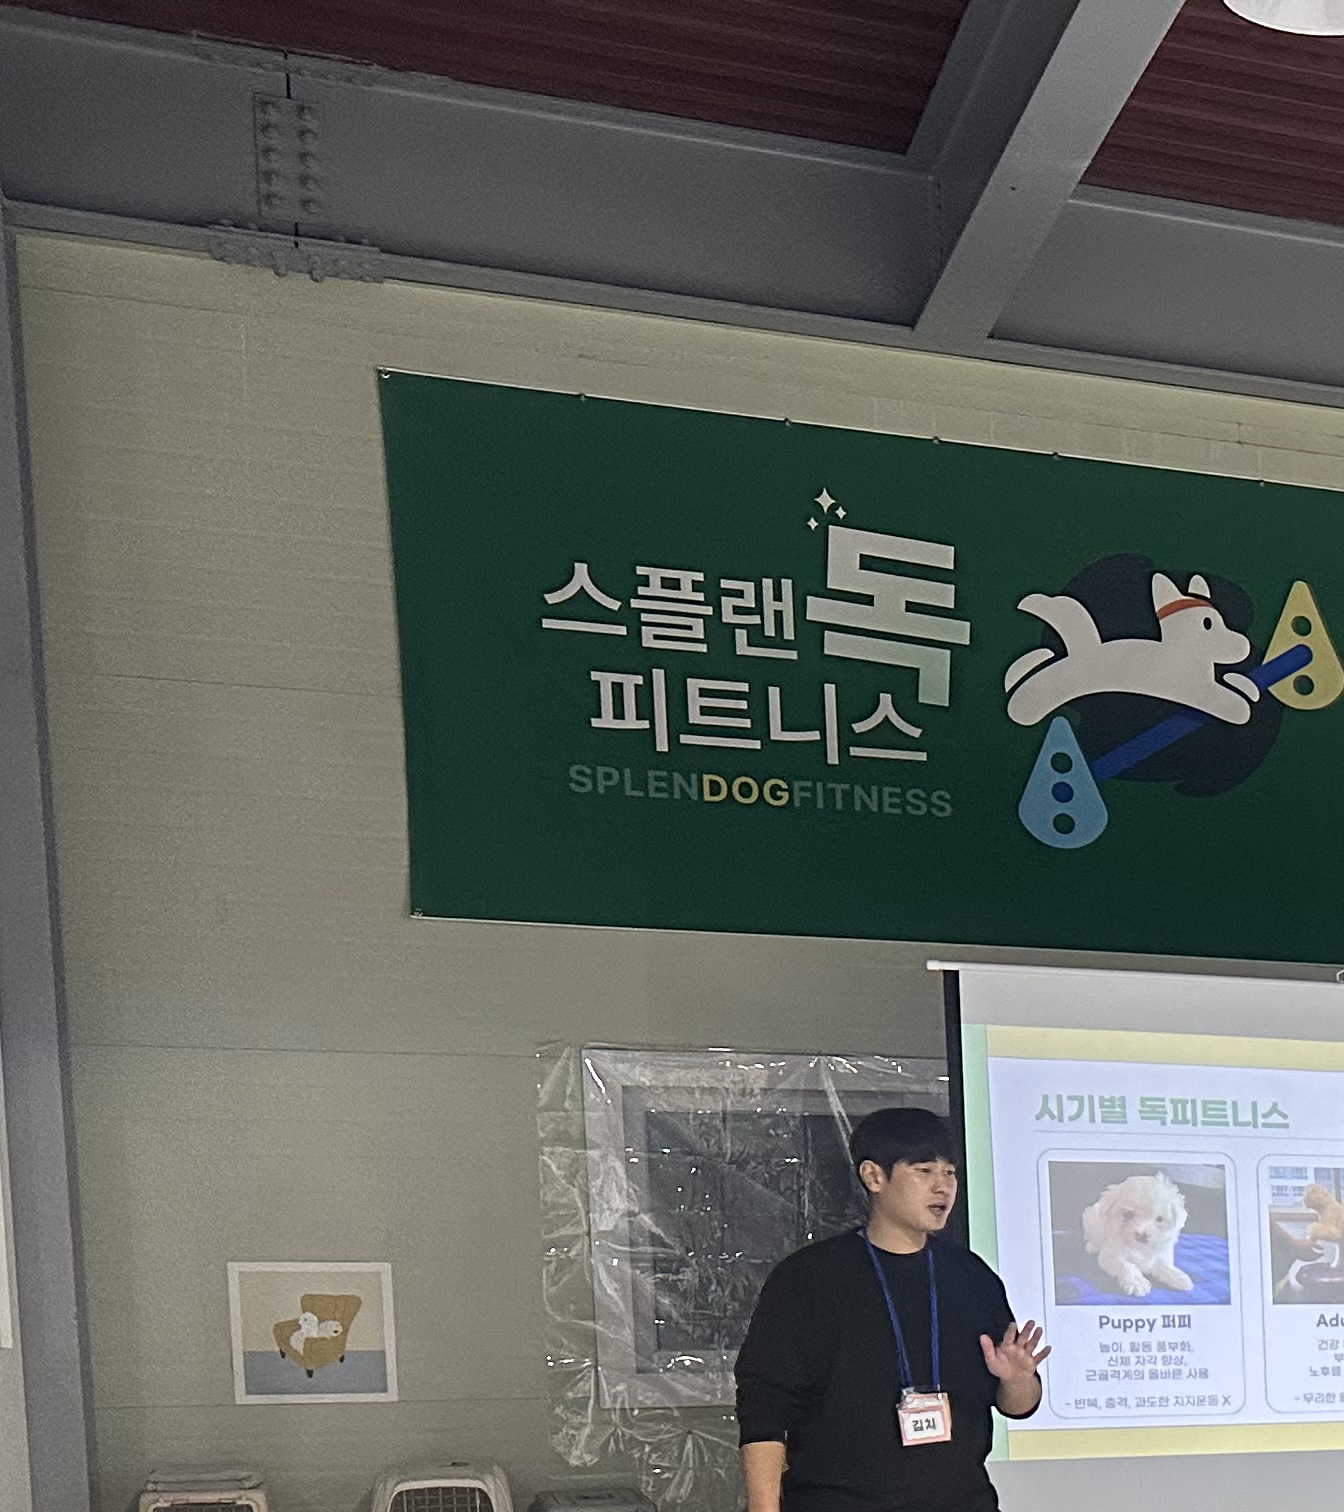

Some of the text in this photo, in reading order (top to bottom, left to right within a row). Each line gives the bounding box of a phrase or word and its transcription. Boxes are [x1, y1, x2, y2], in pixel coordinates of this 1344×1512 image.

[541, 524, 971, 707] 스플랜독
[590, 666, 928, 765] 피트니스
[567, 762, 954, 819] SPLENDOGFITNESS
[1034, 1094, 1290, 1129] 시기별 독피트니스
[1098, 1314, 1192, 1333] Puppy 퍼피
[1318, 1339, 1339, 1350] 건강
[1108, 1355, 1131, 1367] 신체
[1149, 1368, 1183, 1380] 올바른
[1186, 1367, 1209, 1380] 사용
[1309, 1365, 1341, 1377] 노후를
[1135, 1396, 1170, 1408] 과도한
[1303, 1392, 1336, 1404] 무리한
[911, 1417, 937, 1432] 김치
